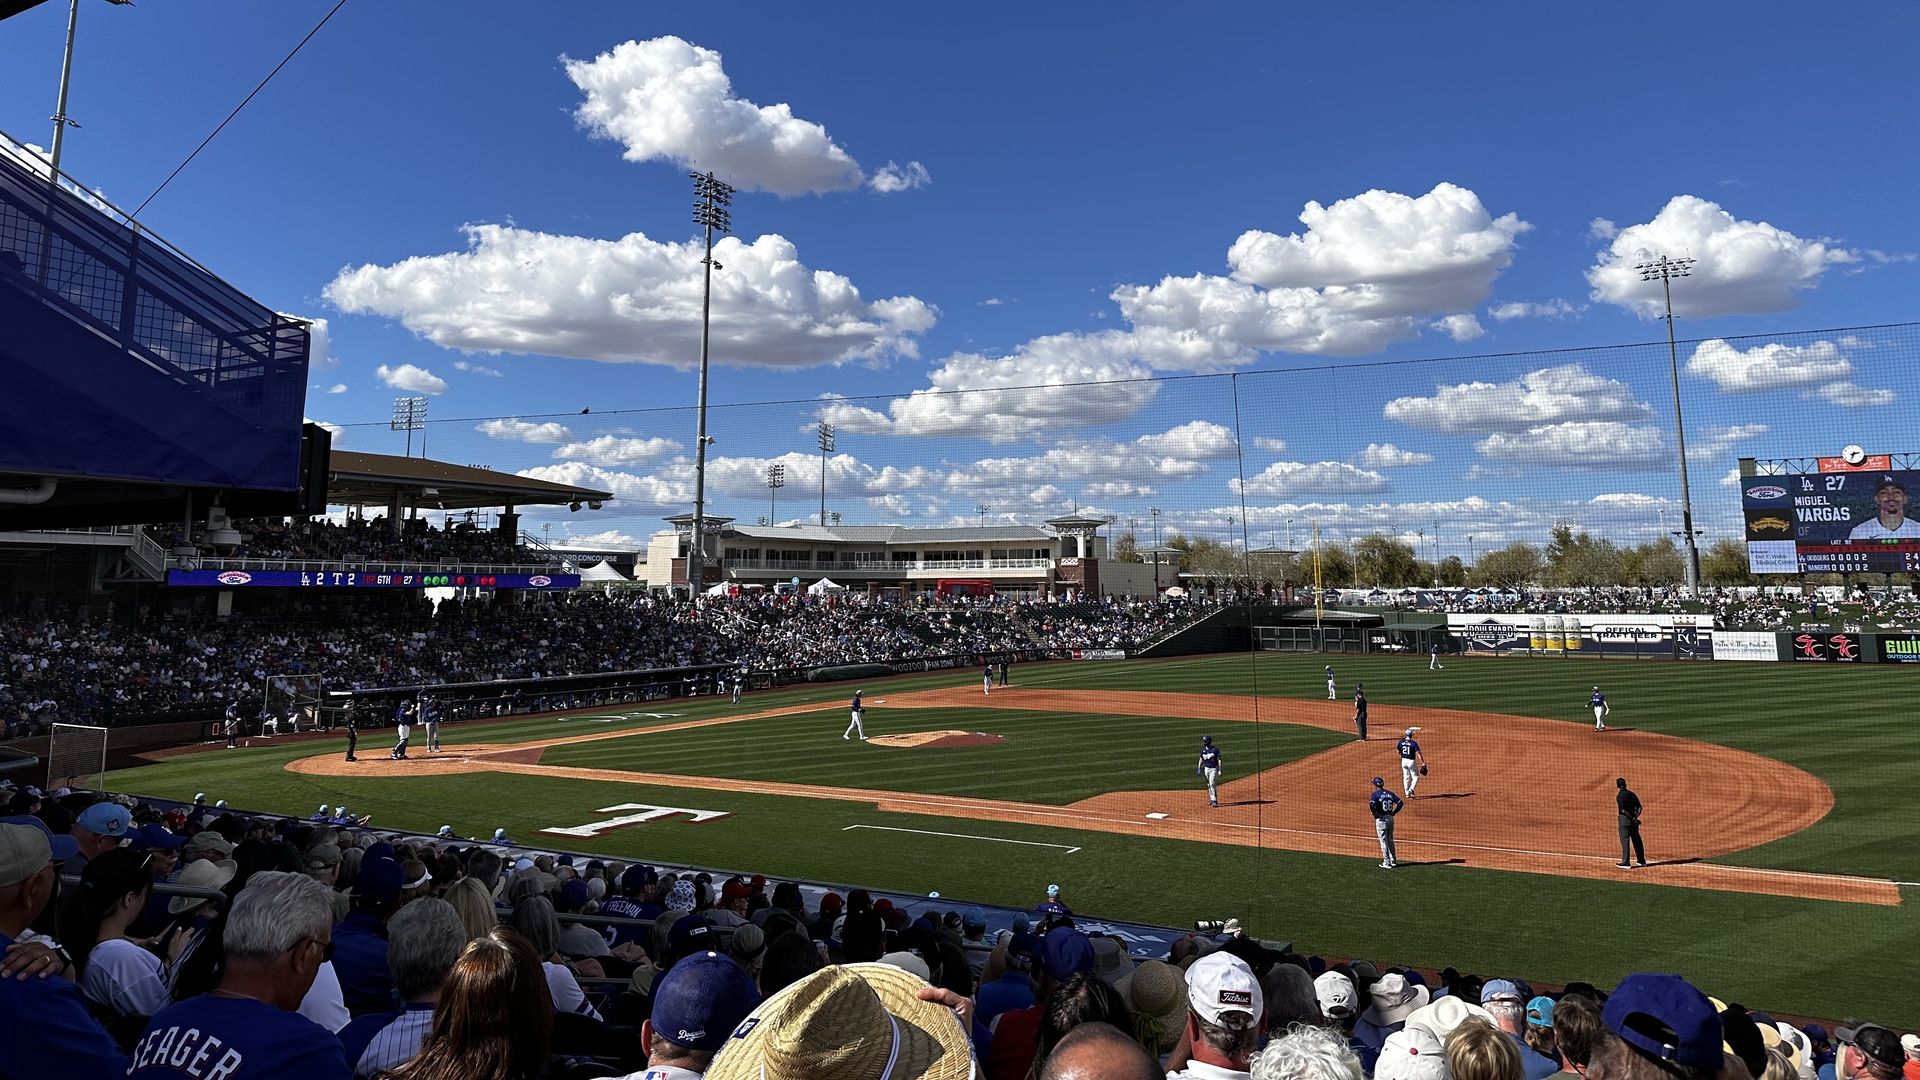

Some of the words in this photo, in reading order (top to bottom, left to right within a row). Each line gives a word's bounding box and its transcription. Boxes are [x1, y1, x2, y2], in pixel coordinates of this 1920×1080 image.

[1825, 476, 1846, 491] 27
[1795, 496, 1830, 506] MIGUEL
[1795, 507, 1850, 522] VARGAS
[1798, 527, 1810, 536] OF
[301, 573, 310, 586] LA
[316, 572, 324, 585] 2
[332, 572, 343, 585] T
[347, 573, 355, 585] 2
[377, 575, 391, 585] 6TH
[403, 575, 413, 585] 27
[1402, 746, 1411, 755] 21
[537, 802, 734, 838] T
[606, 900, 642, 918] FREEMAN
[126, 1026, 242, 1080] SEAGER
